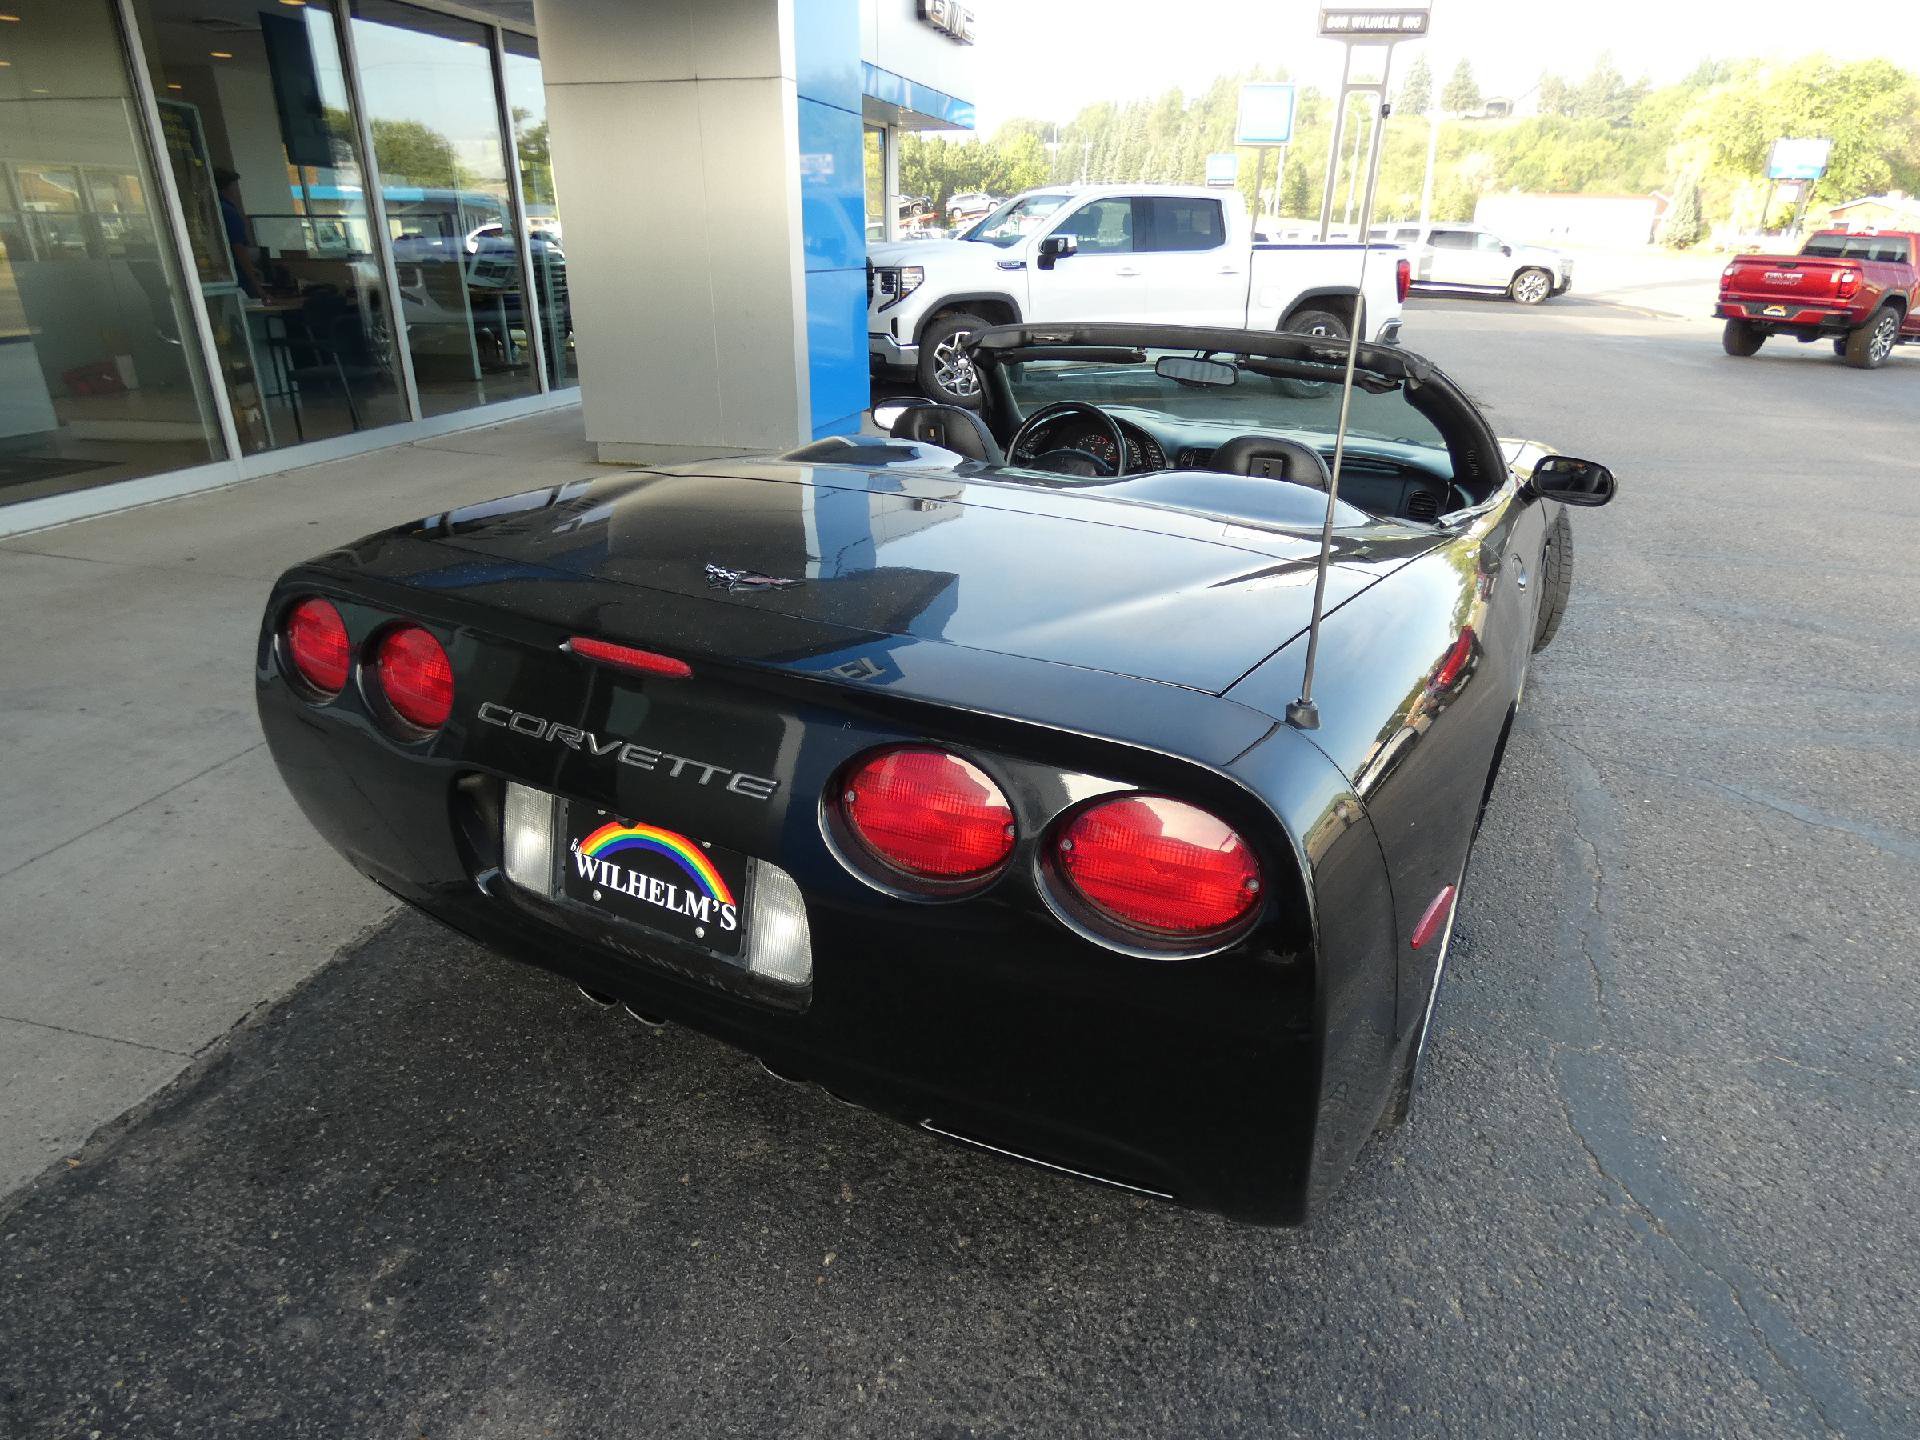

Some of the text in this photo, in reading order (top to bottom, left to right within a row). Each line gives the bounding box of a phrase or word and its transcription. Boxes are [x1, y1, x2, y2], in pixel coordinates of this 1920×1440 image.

[926, 0, 975, 42] GMC
[1351, 15, 1400, 28] WILHELM
[478, 701, 777, 800] CORVETTE
[575, 851, 737, 931] WILHELM'S
